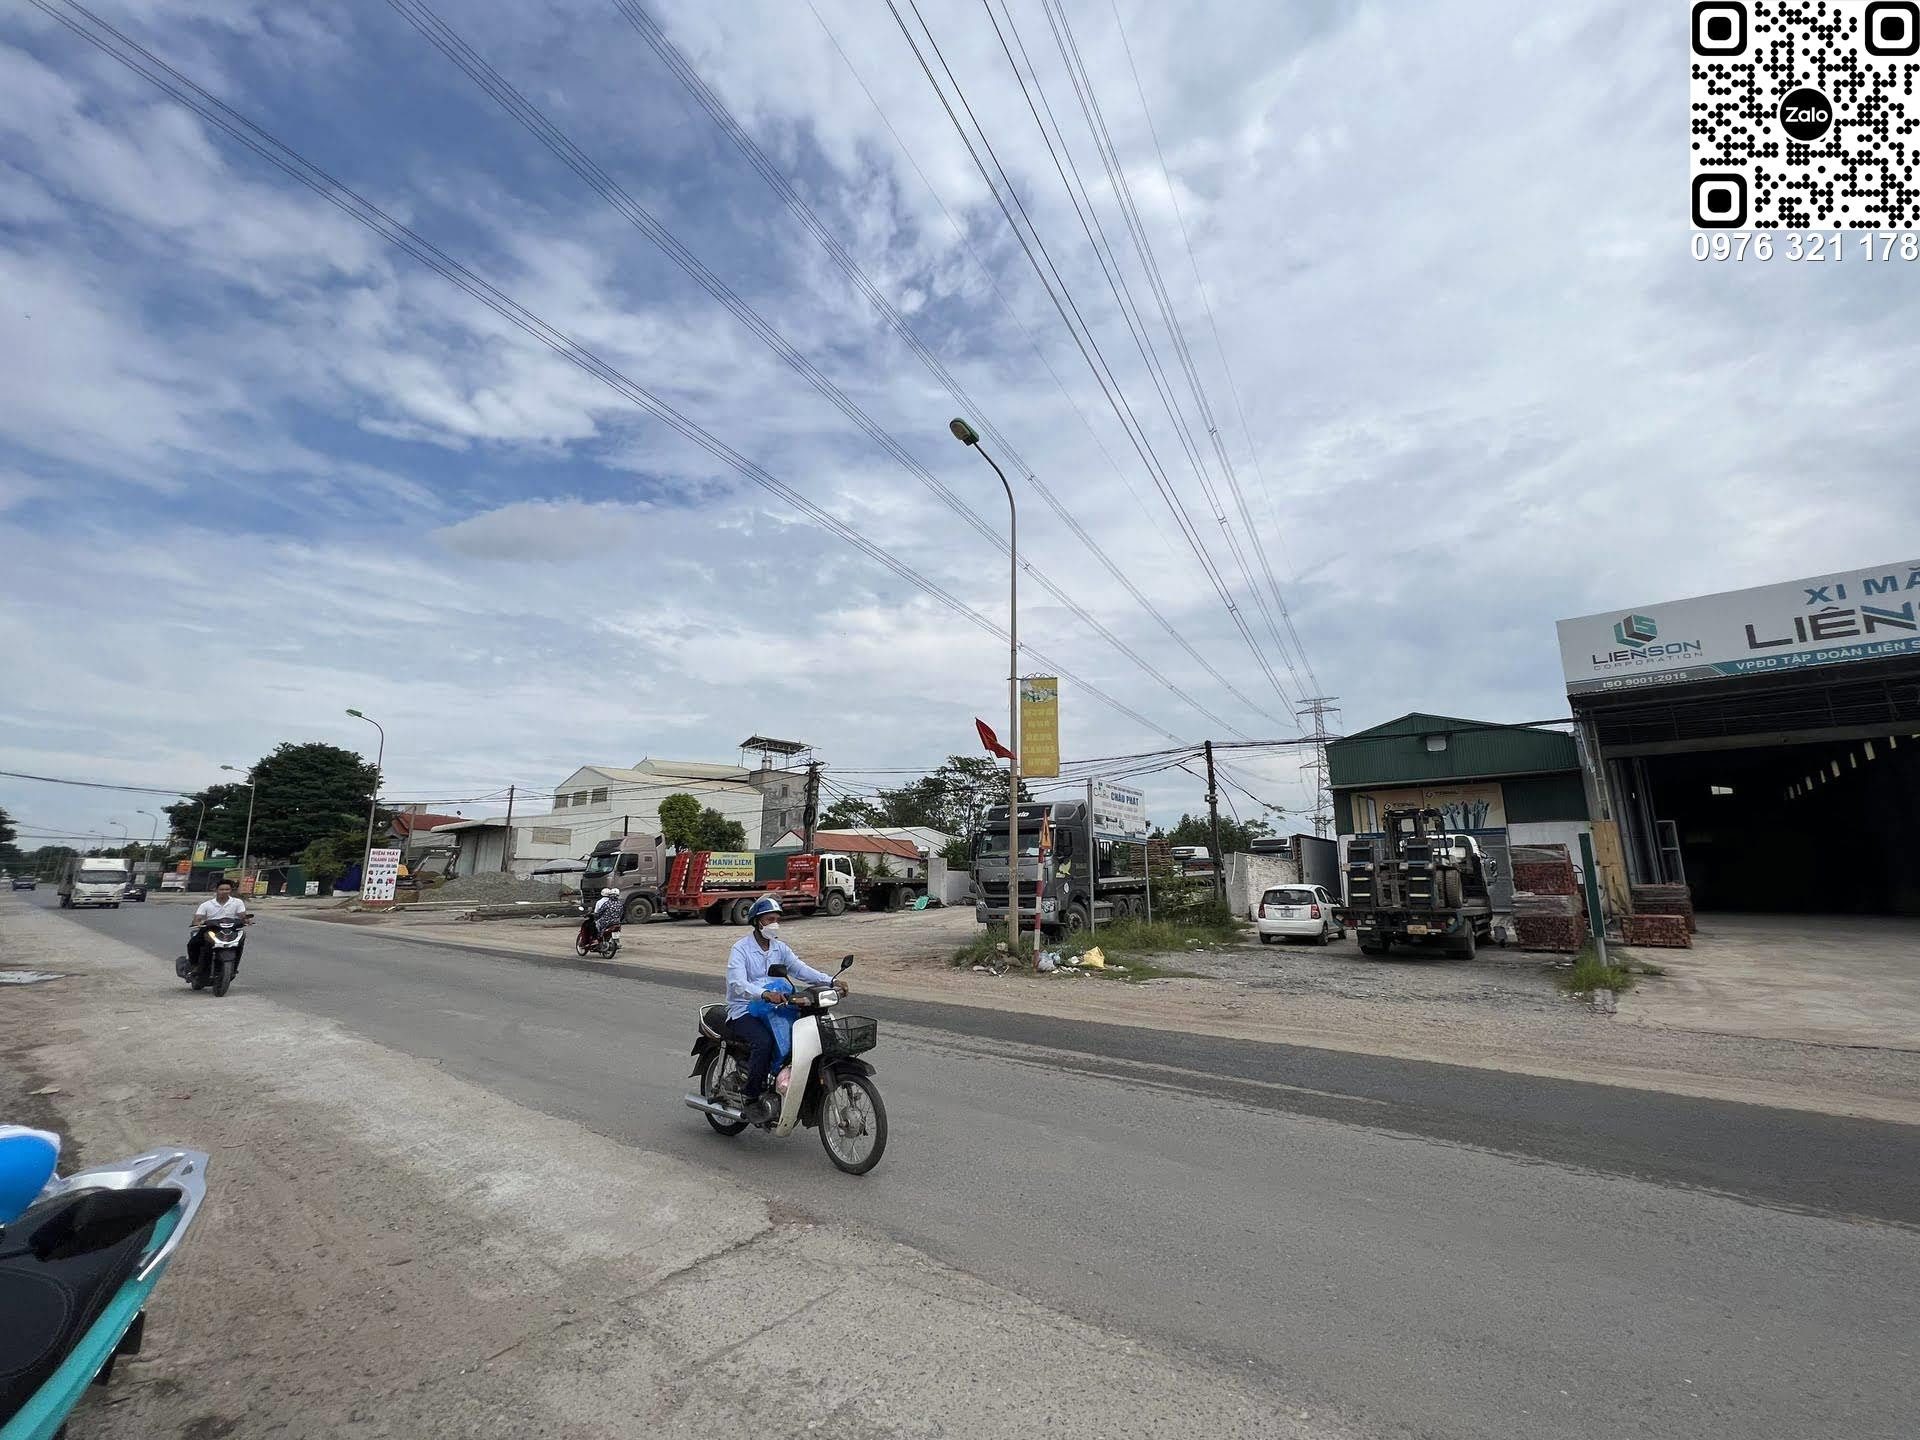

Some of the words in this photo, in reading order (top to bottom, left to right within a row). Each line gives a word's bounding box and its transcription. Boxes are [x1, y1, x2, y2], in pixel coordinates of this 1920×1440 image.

[1804, 584, 1847, 605] XI
[1592, 640, 1702, 665] LIENSON
[1593, 652, 1703, 671] CORPORATION
[1603, 680, 1623, 688] ISO
[1626, 672, 1688, 686] 9001:2015
